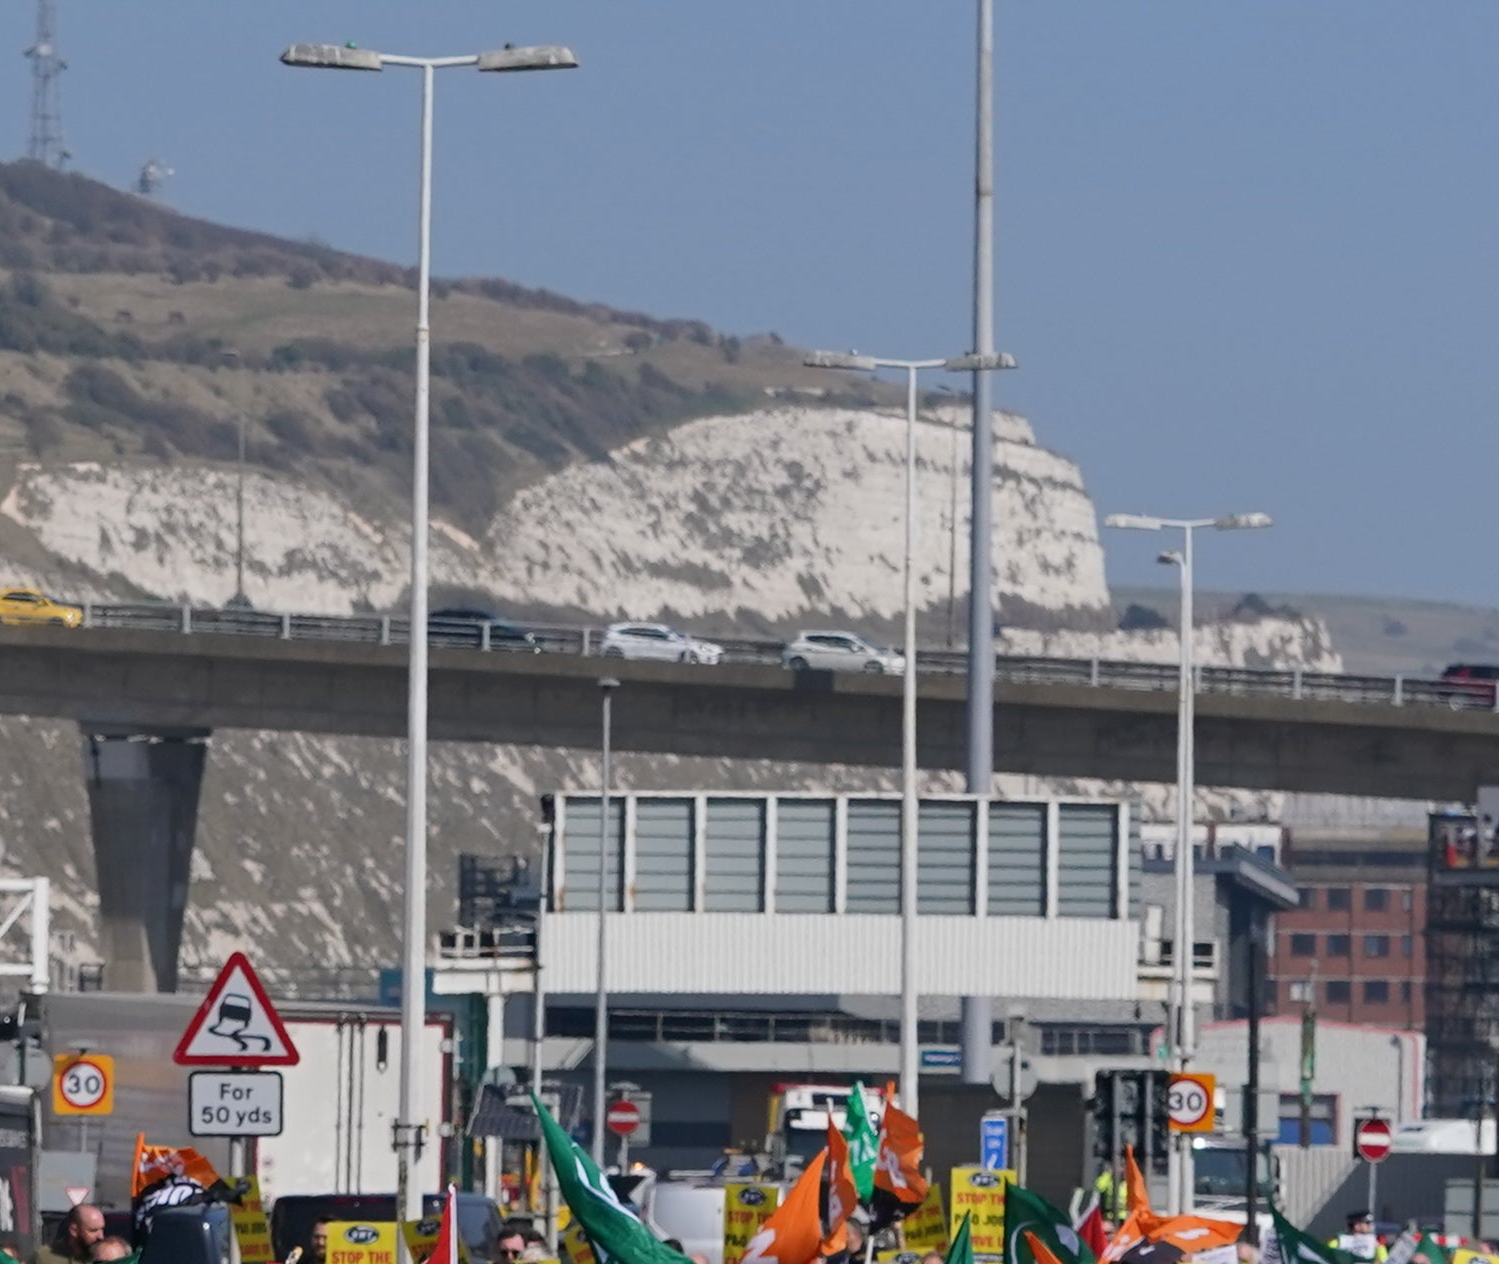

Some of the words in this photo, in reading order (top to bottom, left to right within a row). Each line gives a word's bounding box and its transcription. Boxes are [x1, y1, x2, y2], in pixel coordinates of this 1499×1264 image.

[67, 1074, 101, 1095] 30
[219, 1083, 254, 1101] For
[1169, 1090, 1203, 1113] 30
[202, 1106, 230, 1125] 50
[236, 1106, 273, 1127] yds
[331, 1251, 364, 1264] STOP
[368, 1251, 392, 1264] THE
